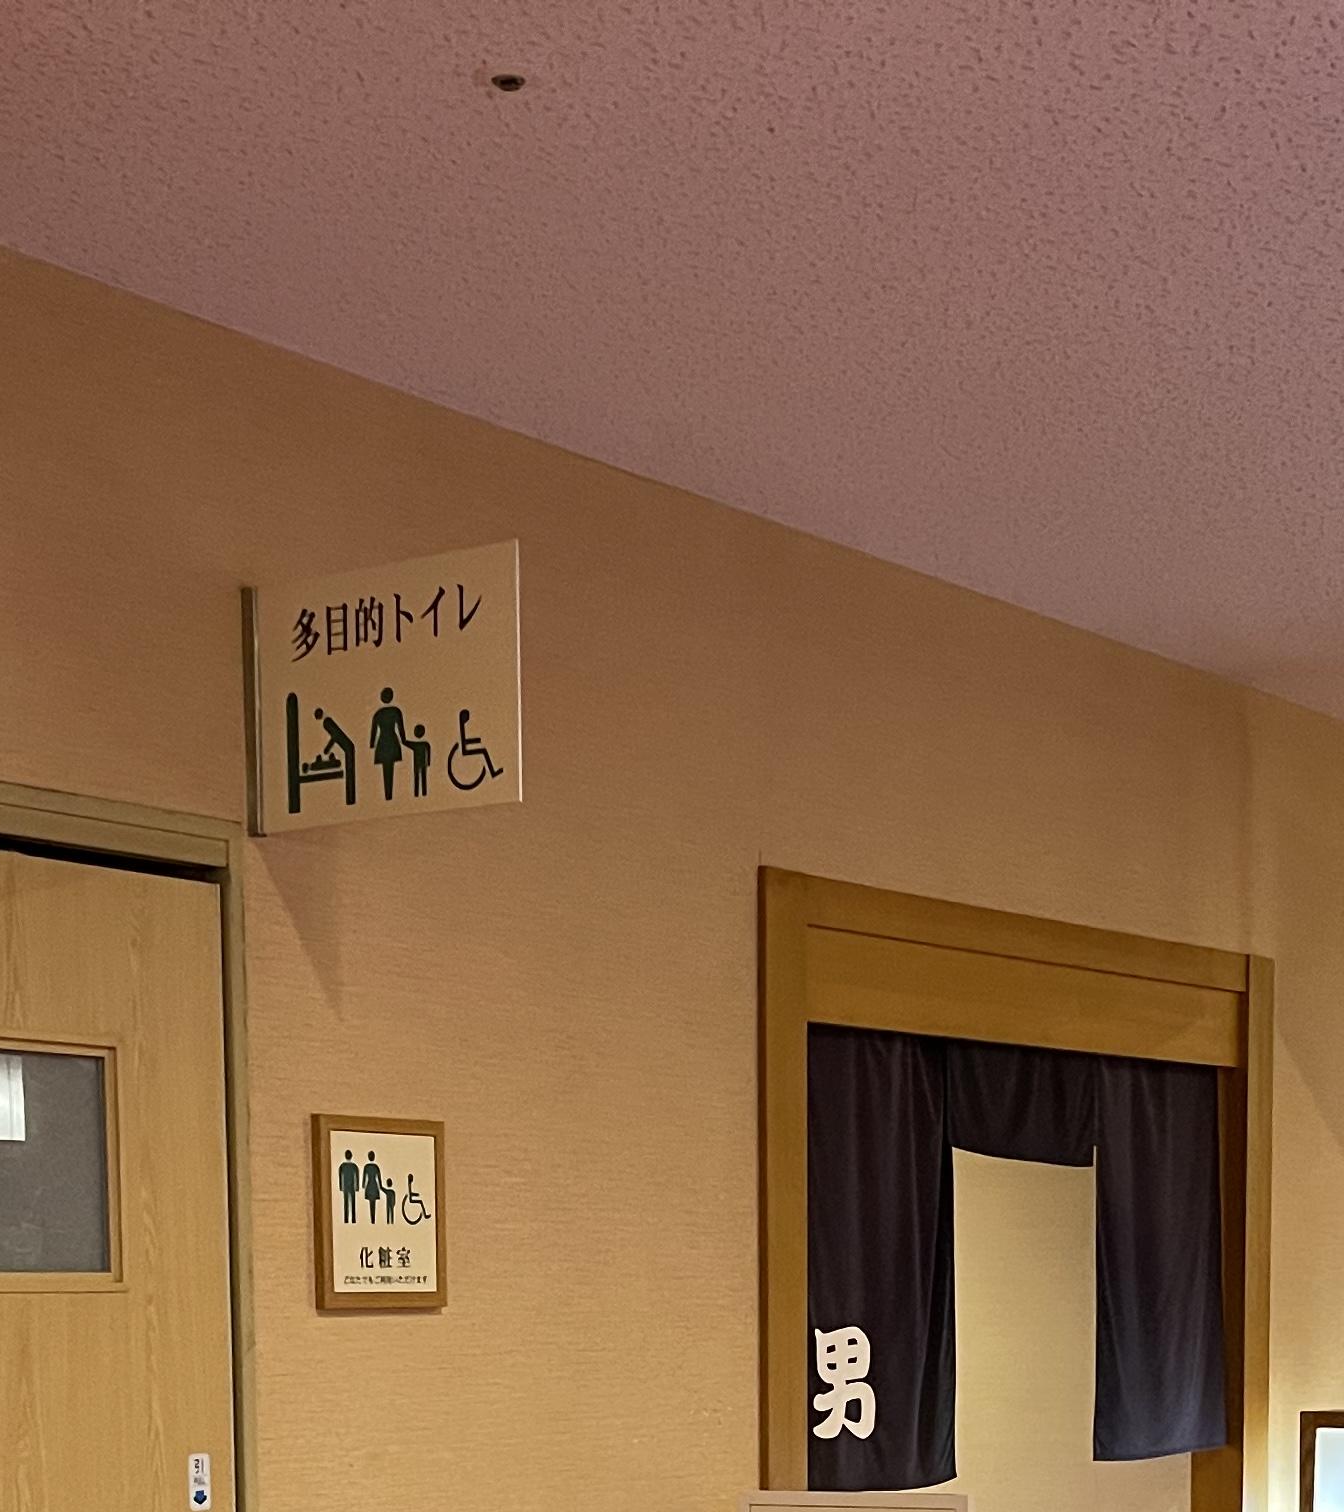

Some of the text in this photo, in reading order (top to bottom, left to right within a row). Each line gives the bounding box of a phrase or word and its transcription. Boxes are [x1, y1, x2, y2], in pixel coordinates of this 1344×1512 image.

[291, 583, 483, 664] 多目的トイレ
[812, 1325, 877, 1440] 男
